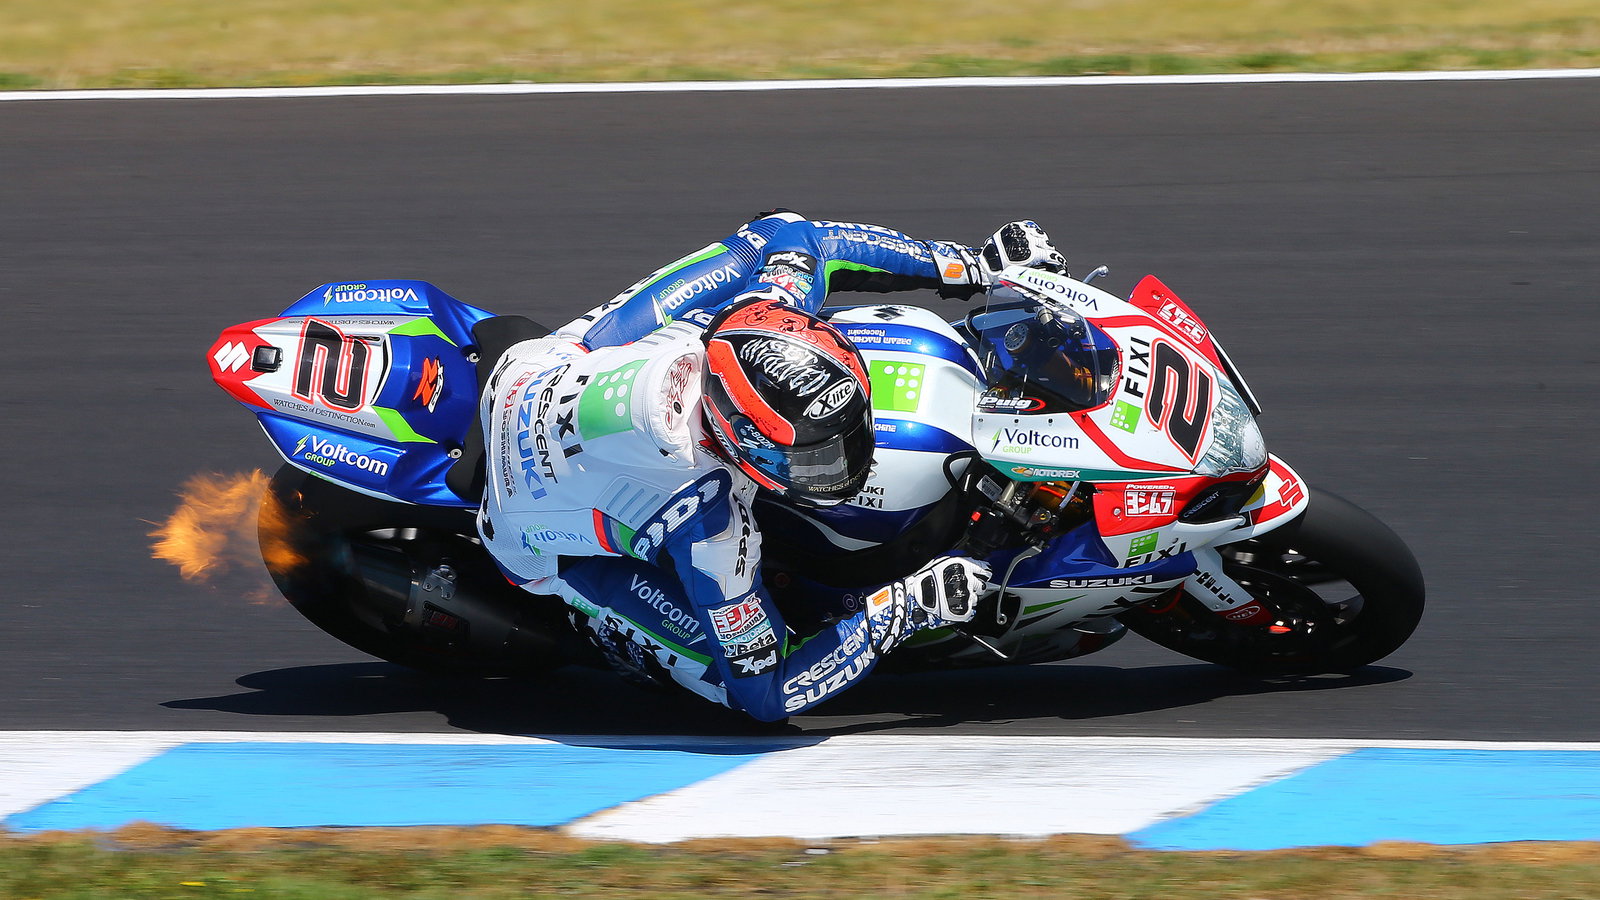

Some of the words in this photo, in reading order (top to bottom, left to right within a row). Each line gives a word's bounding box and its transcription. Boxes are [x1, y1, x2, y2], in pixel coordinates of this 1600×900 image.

[335, 283, 366, 291] GROUP
[335, 287, 419, 302] Voltcom
[659, 278, 686, 300] GROUP
[667, 262, 742, 310] Voltcom
[1028, 276, 1099, 312] Voltcom
[290, 315, 372, 414] 2
[1125, 335, 1151, 399] FIXI
[273, 398, 309, 412] WATCHES
[314, 407, 376, 429] DISTINCTION.com
[816, 381, 853, 418] X-lite
[978, 395, 1033, 408] Puig
[1145, 337, 1214, 466] 2
[874, 423, 897, 433] CHINE
[1004, 427, 1080, 450] Voltcom
[304, 451, 336, 467] GROUP
[311, 435, 389, 476] Voltcom
[1002, 445, 1032, 454] GROUP
[1183, 490, 1220, 518] CRESCENT
[1123, 541, 1187, 569] FIXI
[1050, 574, 1153, 589] SUZUKI
[1194, 569, 1235, 605] IRELLI
[629, 573, 700, 634] Voltcom
[661, 618, 691, 640] GROUP
[732, 649, 778, 676] Xpd
